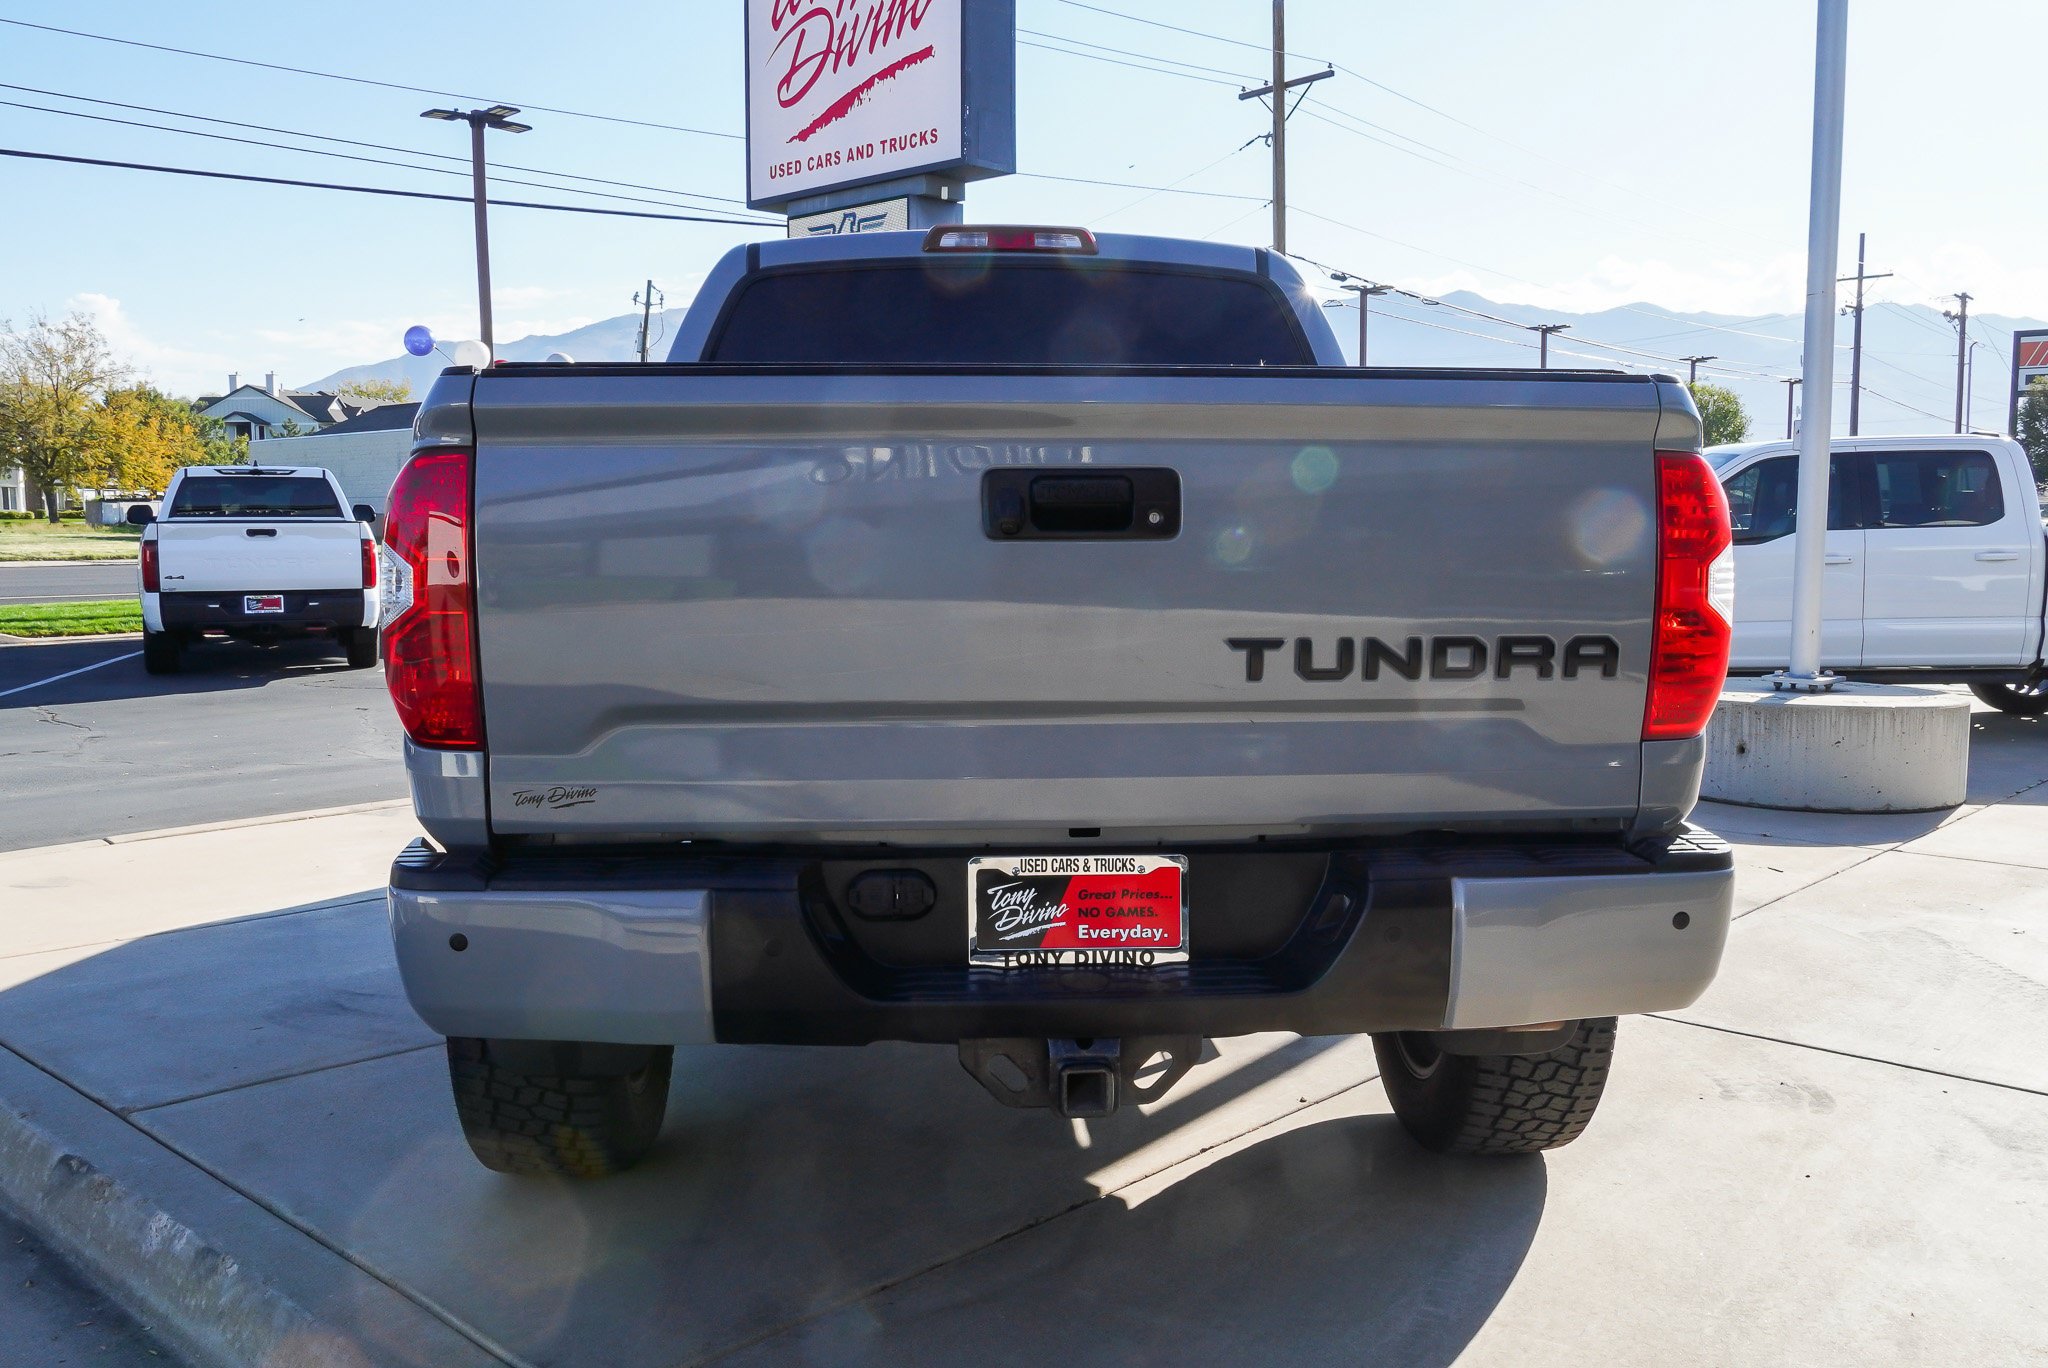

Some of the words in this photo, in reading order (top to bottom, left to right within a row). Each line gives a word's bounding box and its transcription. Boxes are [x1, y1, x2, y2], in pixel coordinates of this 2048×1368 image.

[769, 159, 802, 180] USED
[807, 150, 841, 171] CARS
[847, 143, 874, 163] AND
[880, 128, 938, 155] TRUCKS
[1224, 635, 1621, 682] TUNDRA
[512, 790, 546, 808] Tony
[547, 786, 598, 803] Divino
[1020, 858, 1048, 873] USED
[1051, 858, 1080, 873] CARS
[1082, 858, 1091, 873] &
[1093, 857, 1136, 873] TRUCKS
[987, 881, 1037, 911] Tony
[1078, 889, 1116, 900] Great
[1121, 888, 1173, 900] Prices...
[988, 901, 1070, 932] Divino
[1077, 907, 1100, 918] NO
[1105, 907, 1158, 918] GAMES.
[1078, 924, 1169, 942] Everyday.
[1000, 950, 1064, 967] TONY
[1074, 950, 1155, 966] DIVINO
